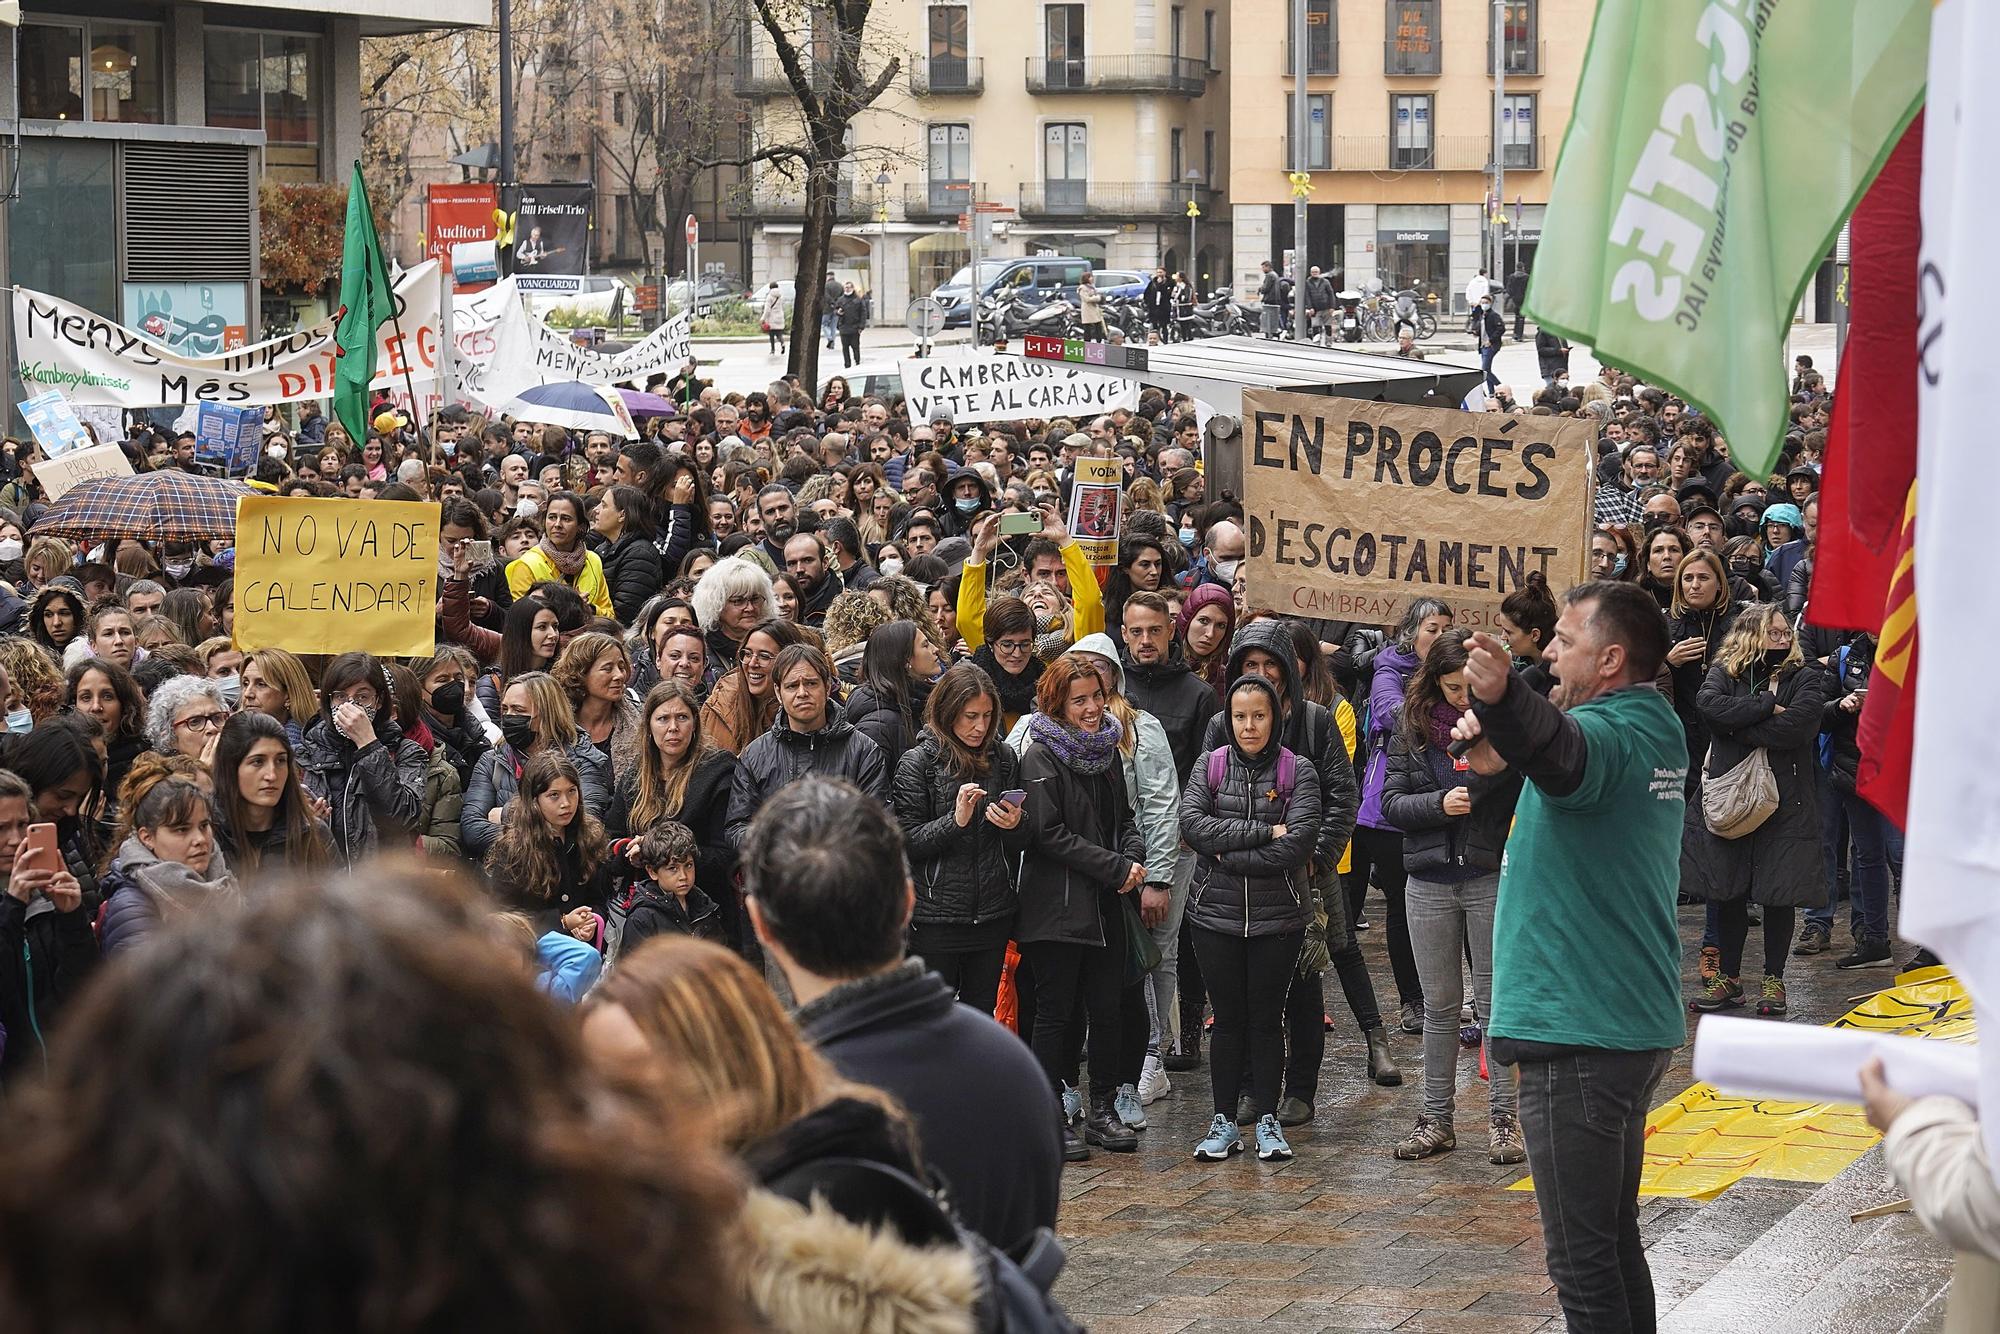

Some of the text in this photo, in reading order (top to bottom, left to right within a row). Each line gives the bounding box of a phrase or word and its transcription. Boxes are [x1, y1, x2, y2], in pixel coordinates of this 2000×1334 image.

[521, 204, 585, 215] Bill Frisell Trio
[430, 240, 443, 254] de
[435, 224, 486, 238] Auditori
[27, 298, 162, 366] Menys
[1027, 341, 1041, 352] L-1
[1046, 342, 1062, 354] L-7
[1064, 345, 1084, 357] L-11
[1086, 347, 1104, 359] L-6
[20, 359, 131, 392] #Cambraydimissió
[1253, 410, 1556, 500] EN PROCÉS
[262, 514, 425, 560] NO VA DE
[1249, 510, 1559, 594] D'ESGOTAMENT
[1292, 586, 1398, 617] CAMBRAY
